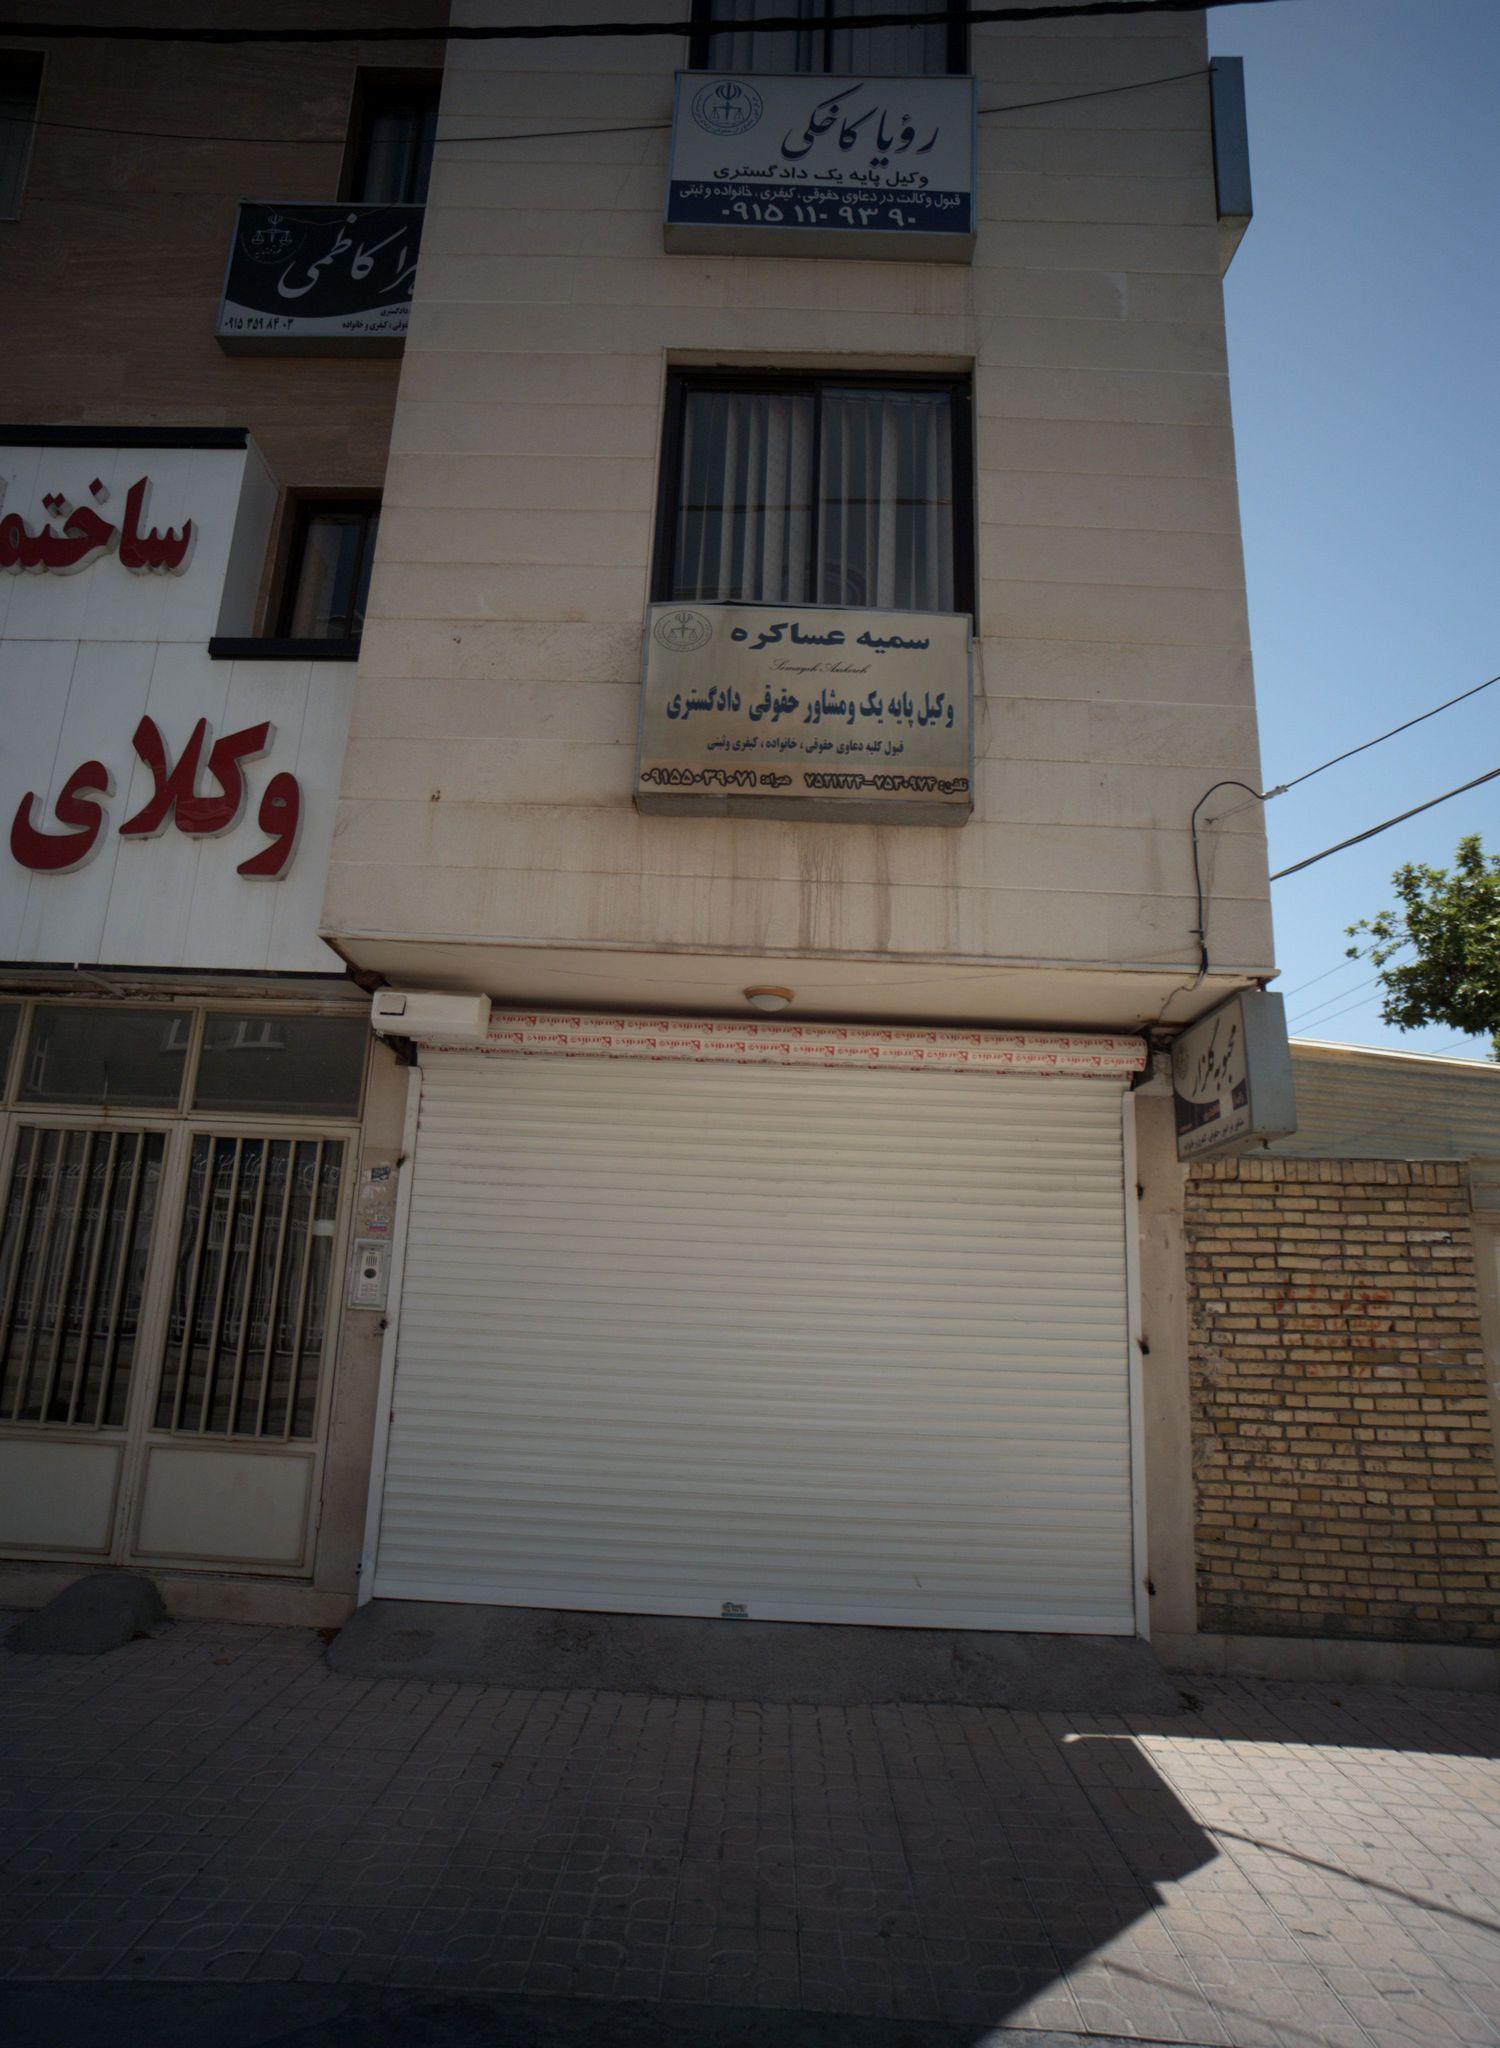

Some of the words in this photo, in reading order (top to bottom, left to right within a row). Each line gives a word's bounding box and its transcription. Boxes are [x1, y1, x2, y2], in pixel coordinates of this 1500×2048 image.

[713, 164, 807, 181] دادگستری
[814, 169, 843, 184] یک
[849, 171, 880, 187] پایه
[886, 173, 929, 189] وکیل
[713, 184, 752, 198] خانواده
[842, 188, 877, 204] دعاوی
[878, 191, 895, 204] در
[896, 191, 932, 208] وکالت
[933, 193, 961, 209] قبول
[722, 201, 785, 222] ۰۹۱۵
[794, 204, 829, 224] ۱۱۰
[838, 205, 879, 226] ۹۳
[888, 209, 917, 228] ۹۰
[277, 213, 408, 300] کاظمی
[730, 621, 846, 651] عساکره
[857, 630, 930, 655] سمیه
[667, 685, 742, 721] دادگستری
[748, 684, 800, 723] حقوقی
[860, 689, 884, 725] یک
[887, 692, 914, 729] پایه
[917, 690, 955, 729] وکیل
[731, 737, 759, 754] کیفری
[836, 740, 865, 756] دعاوی
[865, 740, 883, 755] کلیه
[883, 741, 905, 757] قبول
[10, 715, 304, 884] وکلای
